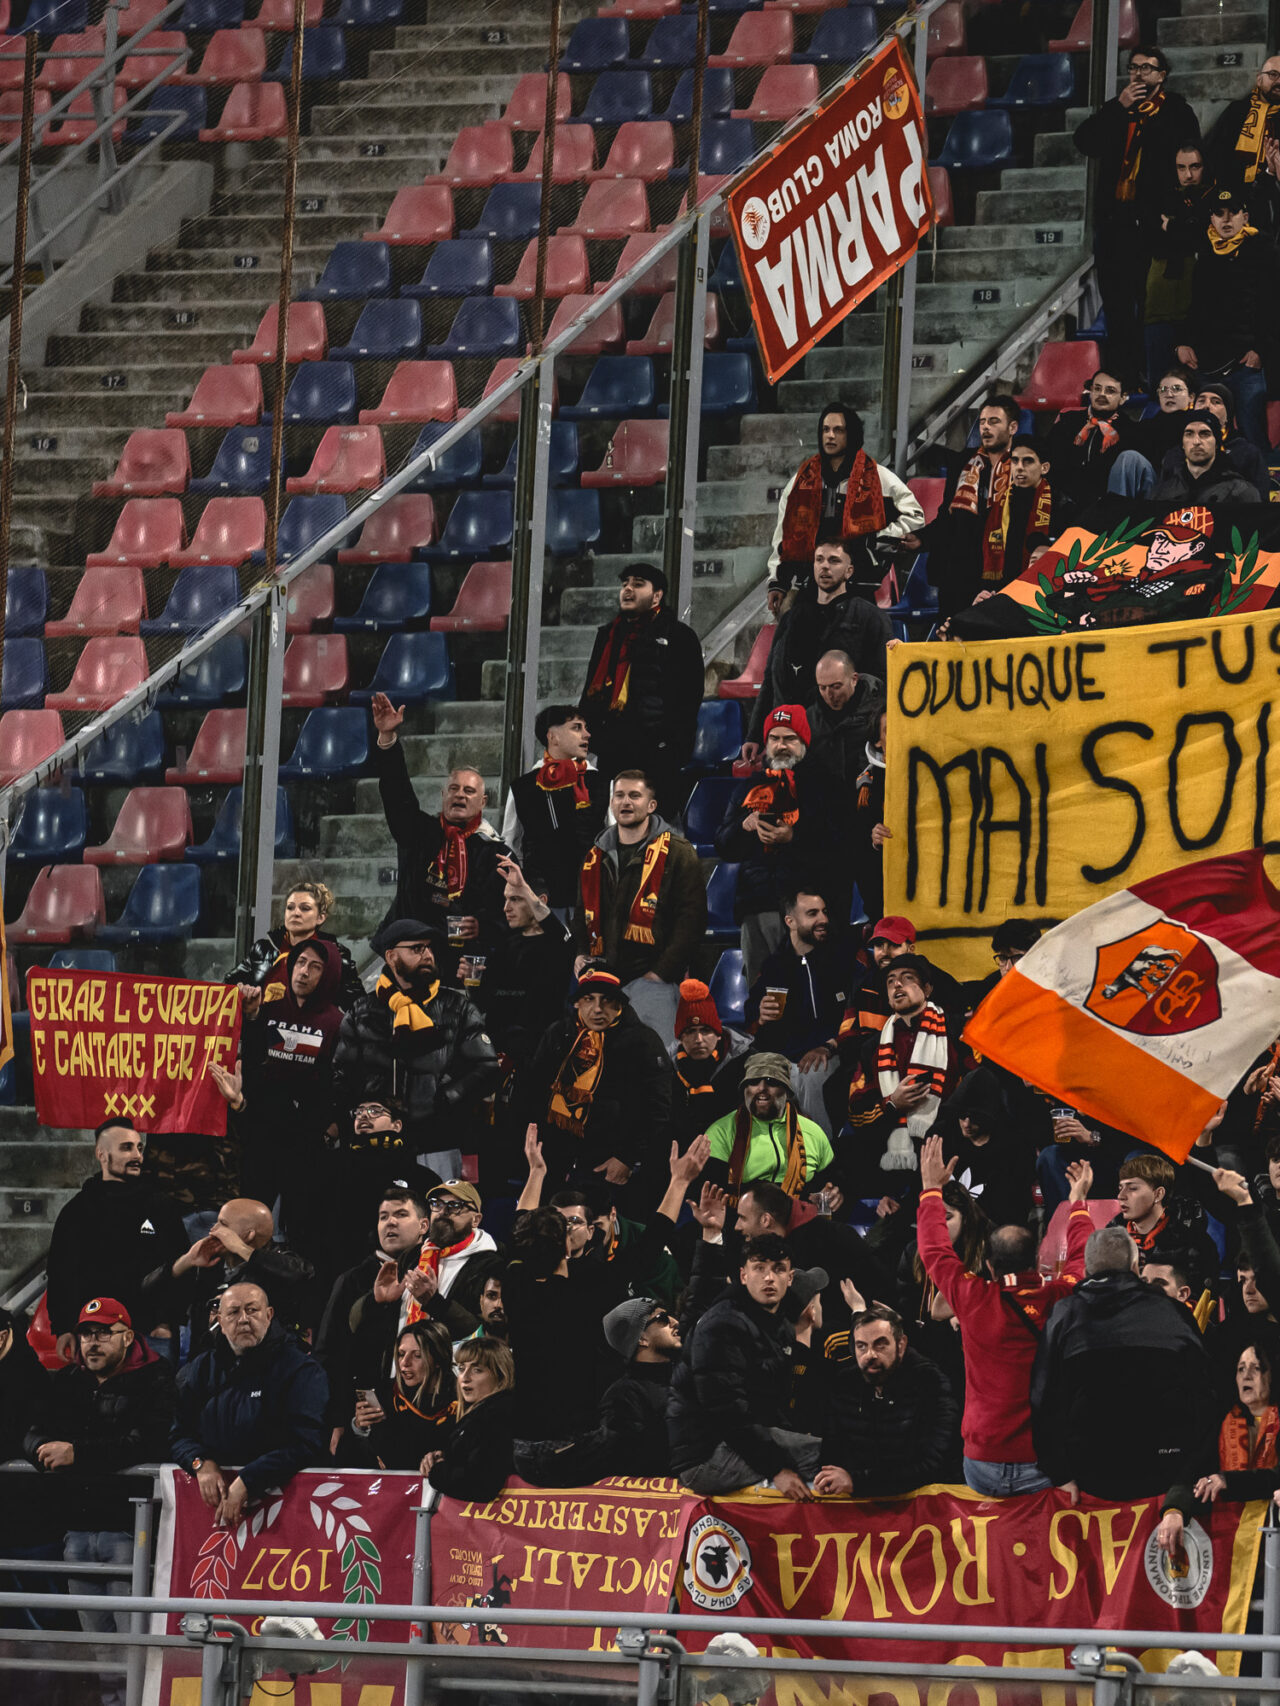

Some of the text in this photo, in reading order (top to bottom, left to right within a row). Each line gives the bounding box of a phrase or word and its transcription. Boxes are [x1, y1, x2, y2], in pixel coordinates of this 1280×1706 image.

[1223, 54, 1237, 65] 22
[824, 95, 883, 169] ROMA
[767, 155, 824, 224] CLUB
[305, 200, 318, 210] 20
[754, 120, 927, 350] PARMA
[1042, 232, 1055, 243] 19
[979, 290, 993, 301] 18
[912, 354, 926, 367] 17
[702, 562, 716, 574] 14
[905, 741, 1050, 913] MAI
[30, 978, 107, 1023] GIRAR
[267, 1019, 324, 1037] PRAHA
[33, 1030, 233, 1081] E CANTARE PER TE
[294, 1054, 316, 1065] TEAM
[23, 1200, 32, 1213] 6
[241, 1547, 334, 1592] 1927
[519, 1545, 674, 1597] SOCIALI
[768, 1503, 1150, 1621] AS ROMA
[1191, 1549, 1210, 1602] UNIONE
[687, 1580, 707, 1604] CLB
[710, 1593, 736, 1607] ROMA
